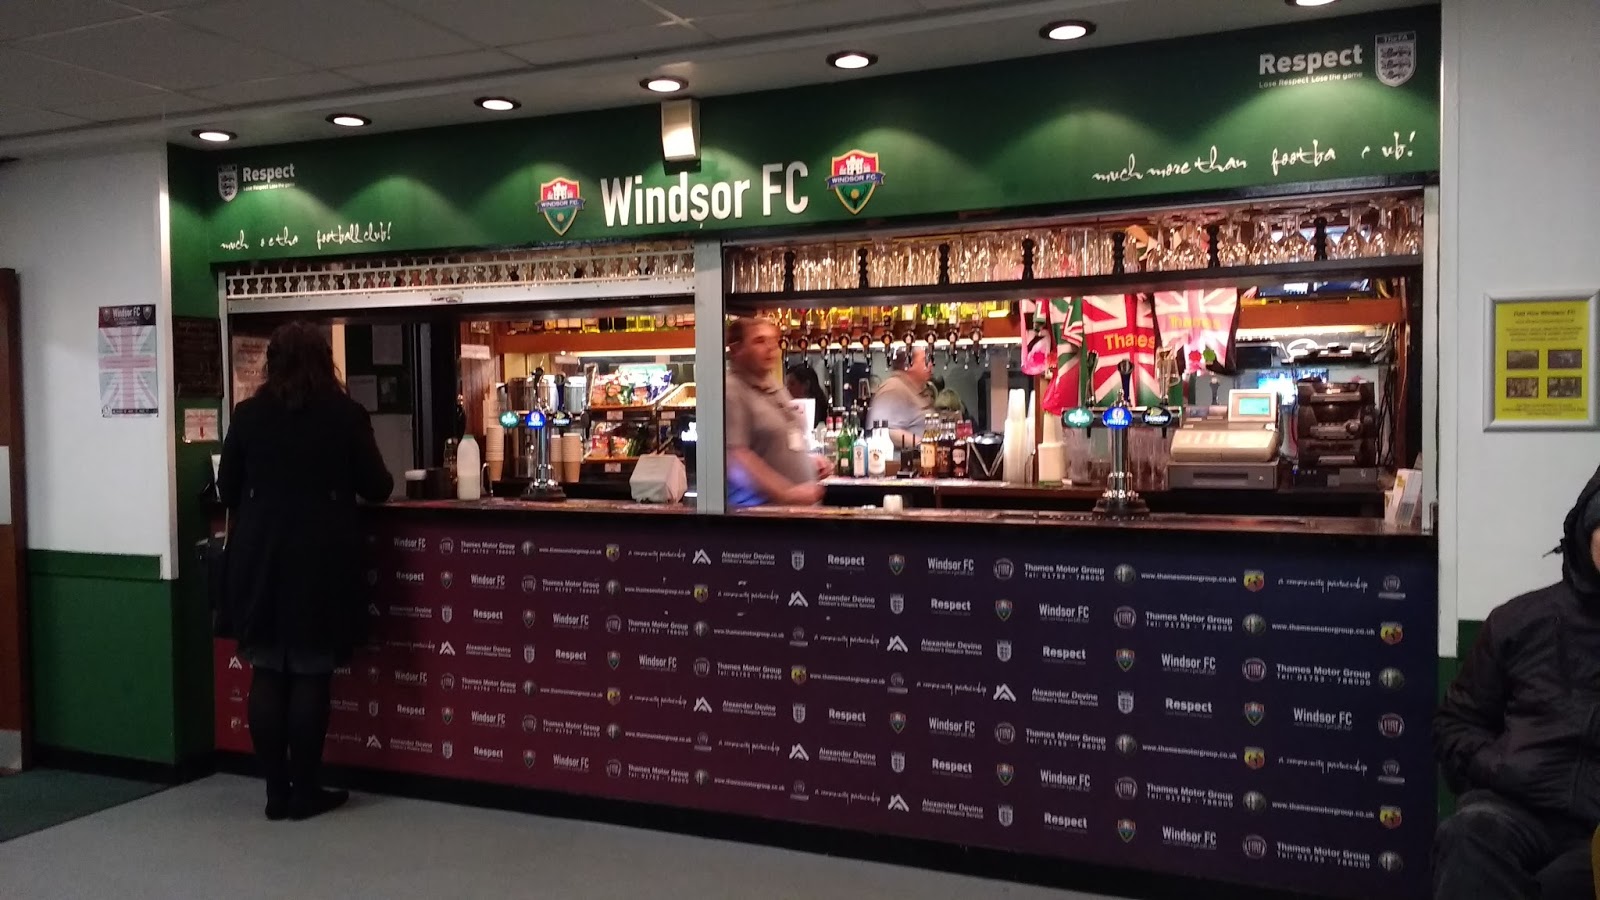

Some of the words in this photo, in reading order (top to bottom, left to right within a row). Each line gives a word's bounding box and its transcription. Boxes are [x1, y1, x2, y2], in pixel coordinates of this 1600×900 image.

[1259, 44, 1363, 75] Respect
[1194, 145, 1247, 174] than
[243, 163, 295, 183] Respect
[600, 171, 750, 228] Windsor
[763, 161, 809, 216] FC
[133, 306, 140, 317] FC
[1104, 333, 1155, 350] Thaes
[827, 554, 864, 567] Respect
[928, 557, 961, 570] Windsor
[964, 559, 974, 571] FC
[931, 598, 971, 612] Respect
[1039, 603, 1076, 617] Windsor
[1078, 606, 1089, 618] FC
[474, 609, 502, 620] Respect
[1146, 612, 1177, 621] Thames
[1180, 614, 1205, 623] Motor
[1208, 615, 1232, 625] Group
[556, 649, 586, 661] Respect
[1043, 646, 1085, 661] Respect
[1162, 654, 1201, 669] Windsor
[1204, 656, 1215, 670] FC
[1277, 664, 1310, 674] Thames
[1314, 666, 1340, 676] Motor
[1344, 668, 1370, 679] Group
[1166, 698, 1212, 714] Respect
[829, 708, 866, 723] Respect
[1293, 708, 1336, 724] Windsor
[1340, 711, 1352, 725] FC
[929, 717, 962, 732] Windsor
[965, 721, 975, 733] FC
[474, 746, 503, 759] Respect
[932, 758, 972, 774] Respect
[1040, 770, 1077, 785] Windsor
[1080, 774, 1090, 787] FC
[1147, 783, 1178, 794] Thames
[1181, 787, 1205, 798] Motor
[1208, 790, 1233, 801] Group
[1044, 812, 1087, 829] Respect
[1163, 826, 1202, 843] Windsor
[1205, 831, 1216, 845] FC
[1277, 842, 1310, 854] Thames
[1314, 846, 1340, 858] Motor
[1343, 850, 1370, 862] Group
